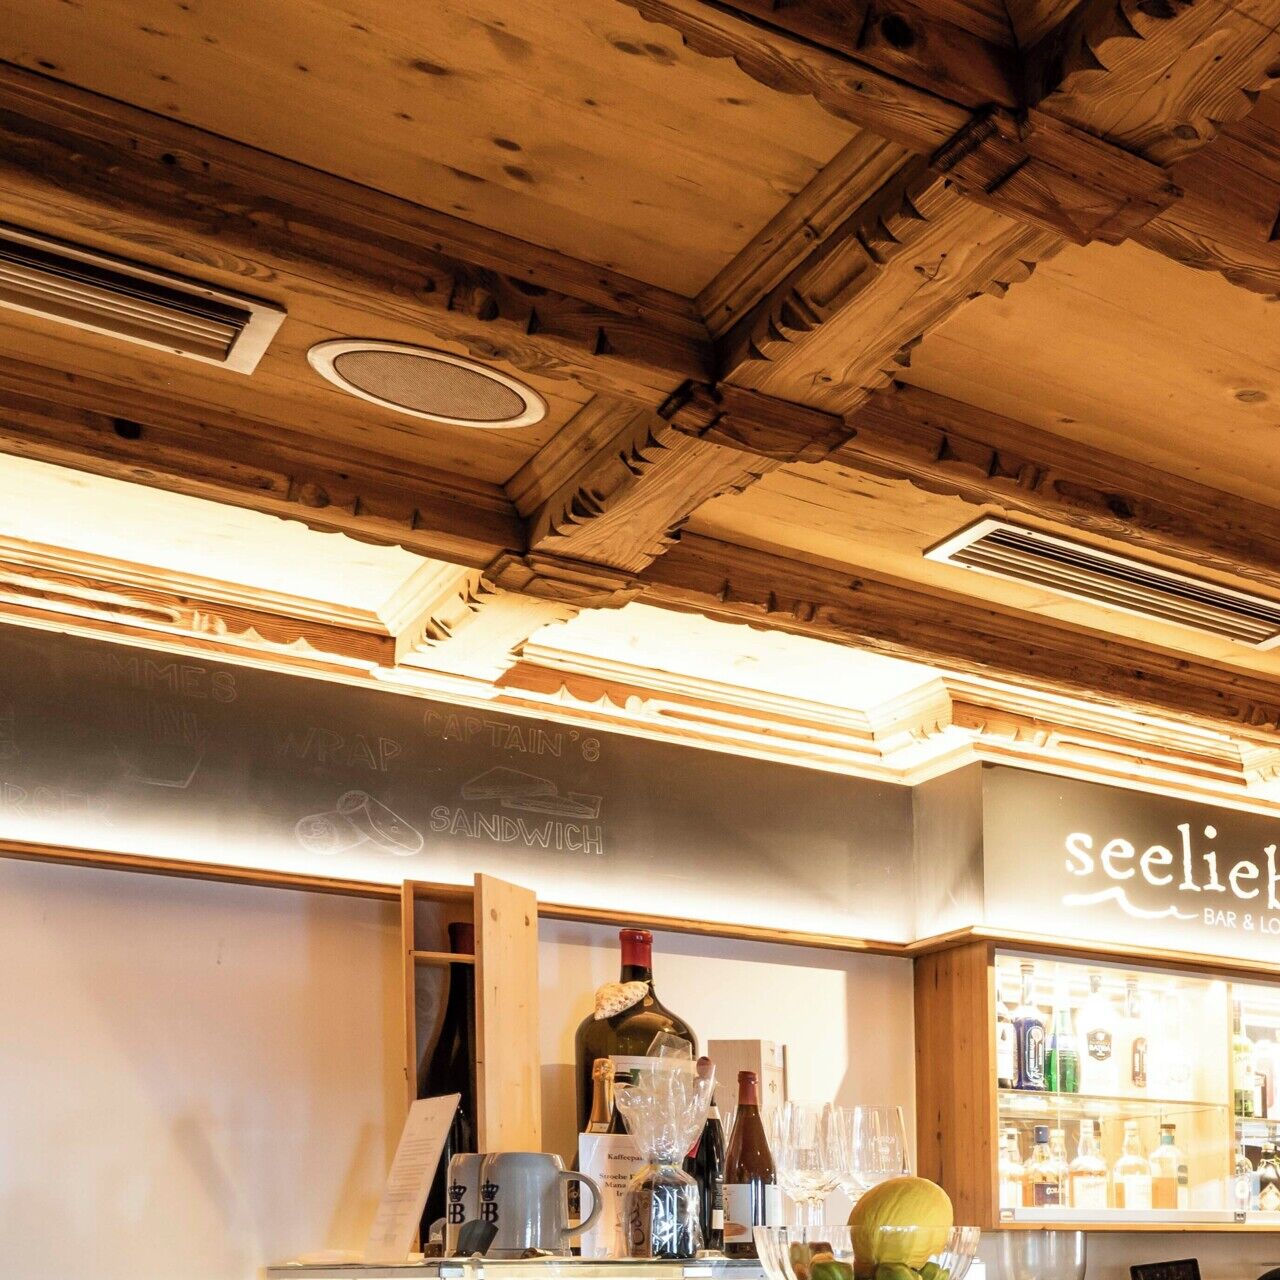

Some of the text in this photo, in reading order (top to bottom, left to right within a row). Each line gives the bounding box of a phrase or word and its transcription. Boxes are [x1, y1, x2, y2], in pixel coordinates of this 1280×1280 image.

[429, 805, 604, 855] SANDWICH
[1203, 907, 1238, 929] BAR
[1242, 914, 1255, 931] &
